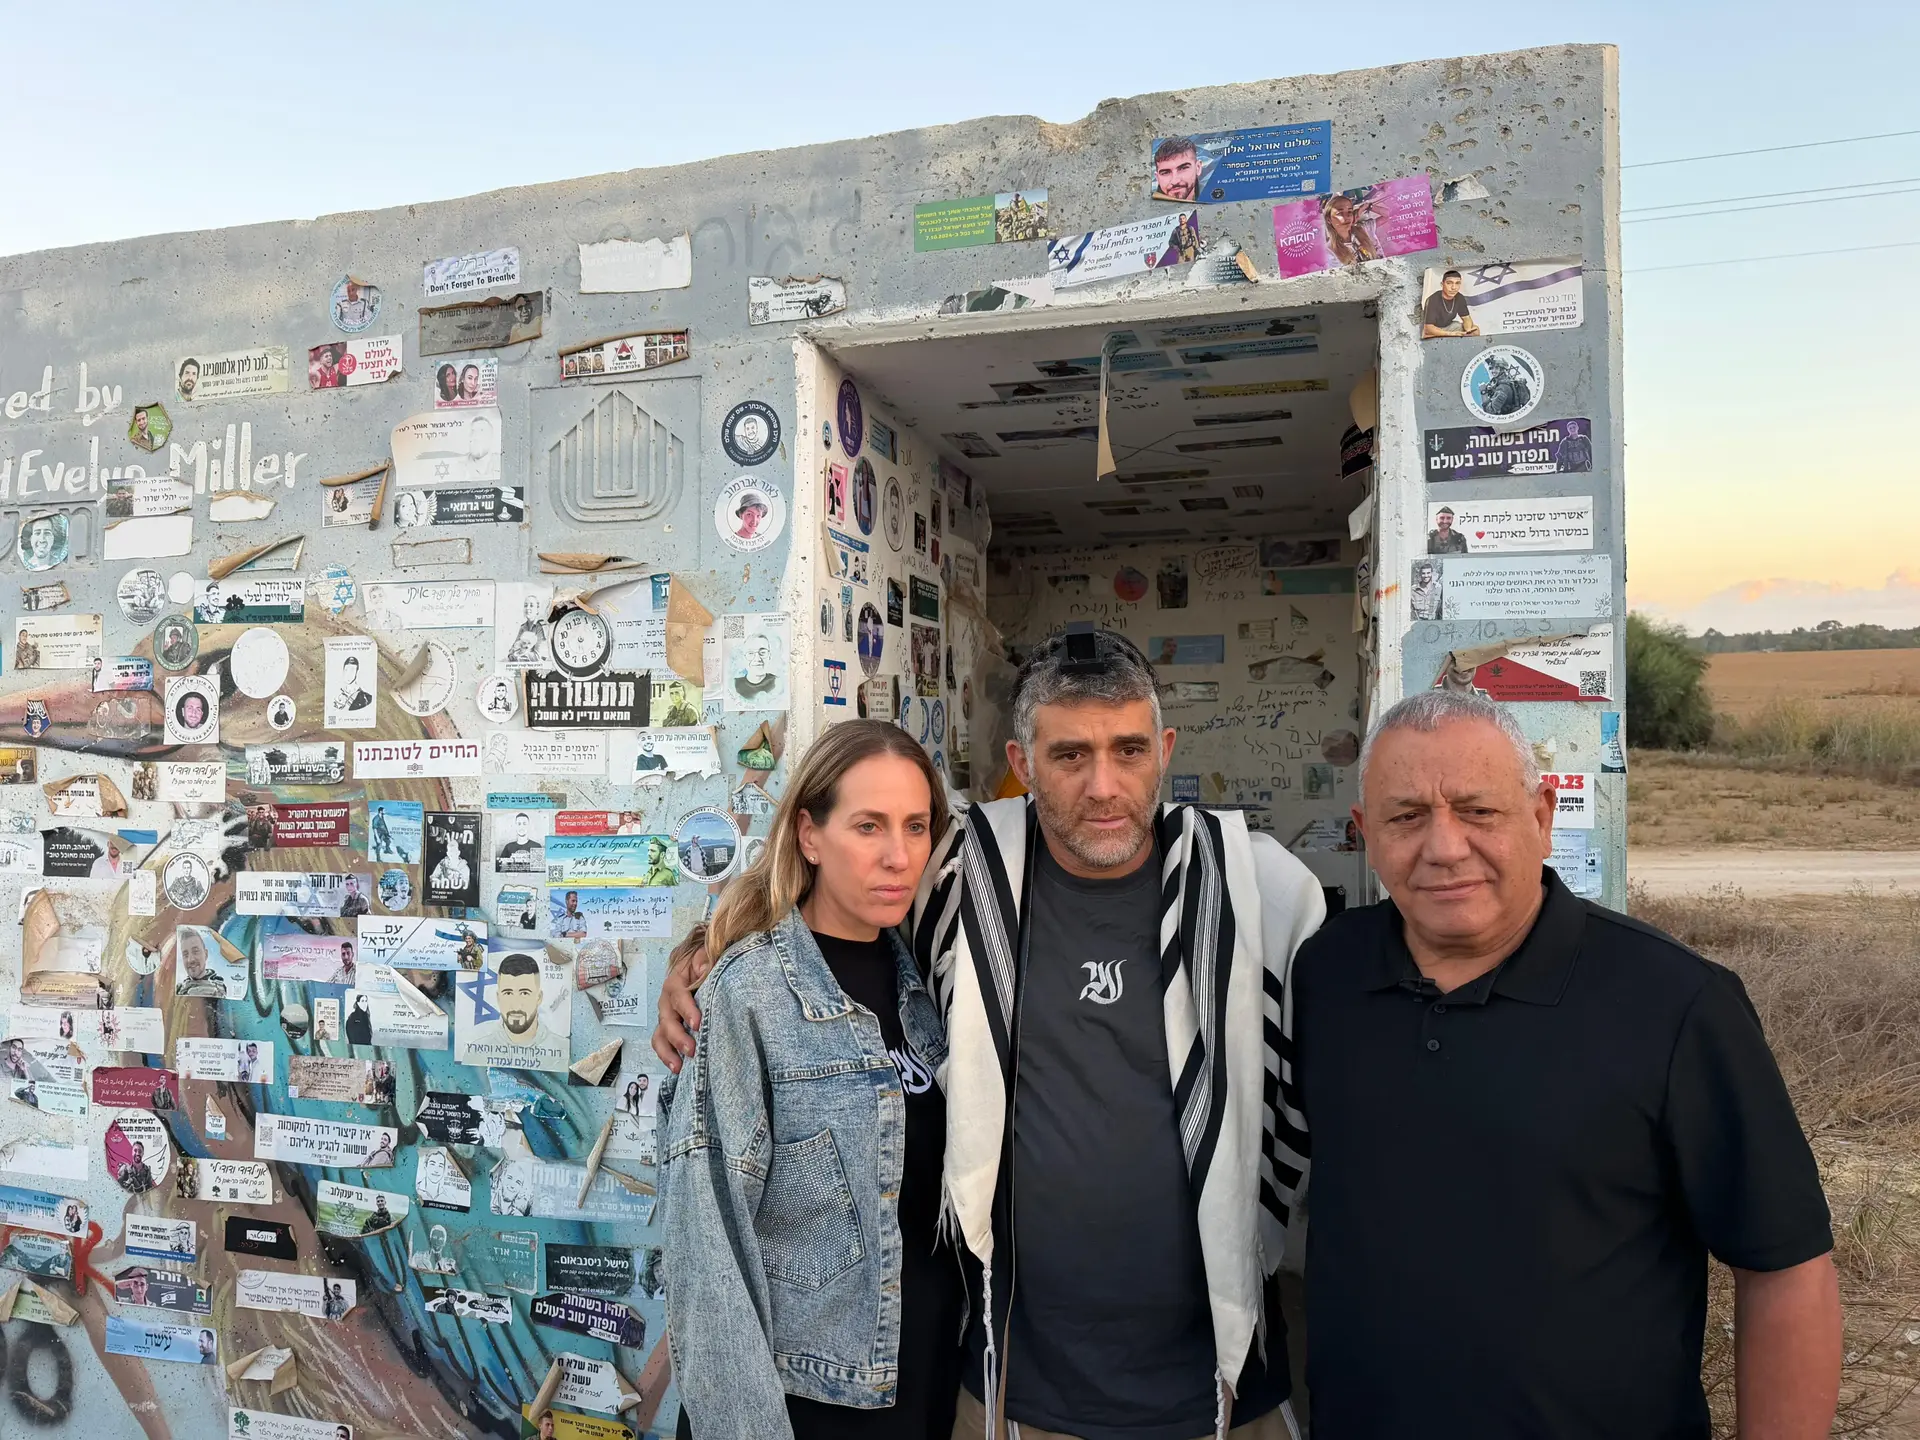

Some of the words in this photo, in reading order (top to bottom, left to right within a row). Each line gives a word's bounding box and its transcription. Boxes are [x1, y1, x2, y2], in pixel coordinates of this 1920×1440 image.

[1249, 142, 1280, 151] אוראל
[1285, 138, 1311, 148] שלום
[1224, 146, 1244, 156] אלון
[1280, 232, 1316, 248] KARIN
[431, 283, 448, 292] Don't
[452, 280, 474, 289] Forget
[488, 273, 515, 283] Breathe
[364, 348, 392, 359] לעולם
[358, 360, 383, 370] תצעד
[385, 357, 398, 368] לא
[370, 370, 386, 379] לבד
[0, 366, 52, 419] ed
[75, 362, 122, 426] by
[1529, 429, 1560, 442] תהיו
[170, 422, 308, 494] Miller
[1478, 452, 1503, 466] טוב
[1508, 449, 1549, 463] תפזרו
[1431, 455, 1474, 469] בעולם
[724, 479, 757, 498] אברמוב
[762, 481, 778, 498] לאור
[482, 501, 494, 510] שי
[1459, 514, 1480, 525] חלק
[1483, 511, 1511, 523] לקחת
[1515, 513, 1546, 522] שזכינו
[1529, 528, 1550, 538] גדול
[1554, 528, 1589, 537] במשהו
[255, 582, 279, 594] הדרך
[265, 593, 289, 601] לחיים
[566, 623, 572, 631] 11
[592, 622, 597, 630] 2
[561, 631, 568, 639] 10
[597, 631, 602, 639] 3
[582, 655, 587, 663] 6
[531, 682, 635, 708] תתעוררו!
[535, 712, 560, 720] חוסל!
[562, 710, 575, 720] לא
[577, 712, 600, 722] עדיין
[603, 712, 630, 720] חמאס
[1286, 727, 1321, 745] עם
[429, 745, 478, 759] החיים
[1244, 734, 1311, 759] ישראל
[357, 743, 421, 762] לטובתנו
[293, 764, 326, 772] השמיים
[1271, 777, 1291, 789] עם
[288, 810, 308, 819] להקריב
[310, 810, 322, 818] צריך
[296, 822, 314, 830] בשביל
[309, 874, 326, 887] זוהר
[329, 875, 342, 889] ירון
[432, 877, 469, 890] נשמה
[239, 891, 258, 901] נצחית
[260, 891, 272, 901] היא
[275, 892, 297, 902] הגאווה
[385, 925, 403, 934] עם
[361, 932, 403, 946] ישראל
[374, 948, 385, 957] חי
[617, 998, 638, 1008] DAN
[467, 1043, 497, 1054] והארץ
[499, 1045, 508, 1053] בא
[530, 1046, 546, 1057] הלך
[548, 1049, 562, 1058] דור
[487, 1057, 513, 1066] עמדת
[514, 1057, 541, 1068] לעולם
[277, 1120, 312, 1133] למקומות
[315, 1125, 330, 1135] דרך
[332, 1128, 361, 1138] קיצורי
[319, 1138, 344, 1152] להגיע
[347, 1143, 368, 1155] ששווה
[356, 1192, 362, 1200] בר
[560, 1256, 601, 1266] ניסנבאום
[604, 1257, 629, 1269] מישל
[150, 1269, 181, 1282] זוהר
[279, 1297, 293, 1306] כמה
[535, 1301, 565, 1319] בעולם
[604, 1303, 626, 1318] תהיו
[568, 1310, 585, 1323] טוב
[588, 1315, 617, 1332] תפזרו
[566, 1358, 585, 1370] שלא
[572, 1374, 591, 1385] עשה
